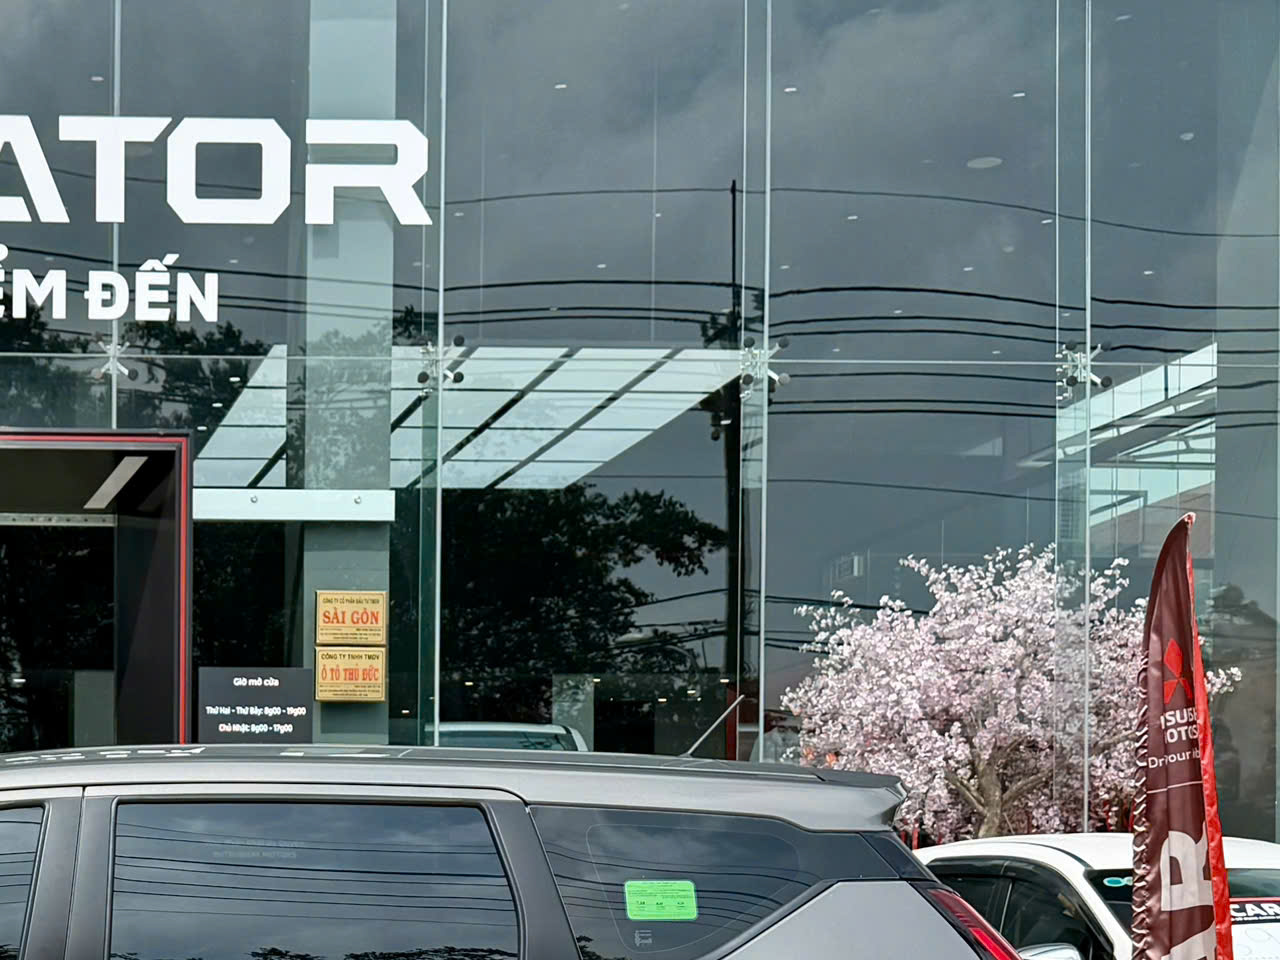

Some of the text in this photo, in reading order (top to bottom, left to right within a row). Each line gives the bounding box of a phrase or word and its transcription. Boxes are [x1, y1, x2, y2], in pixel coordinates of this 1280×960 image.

[83, 253, 219, 322] ĐẾN
[322, 607, 380, 625] SÀI GÒN
